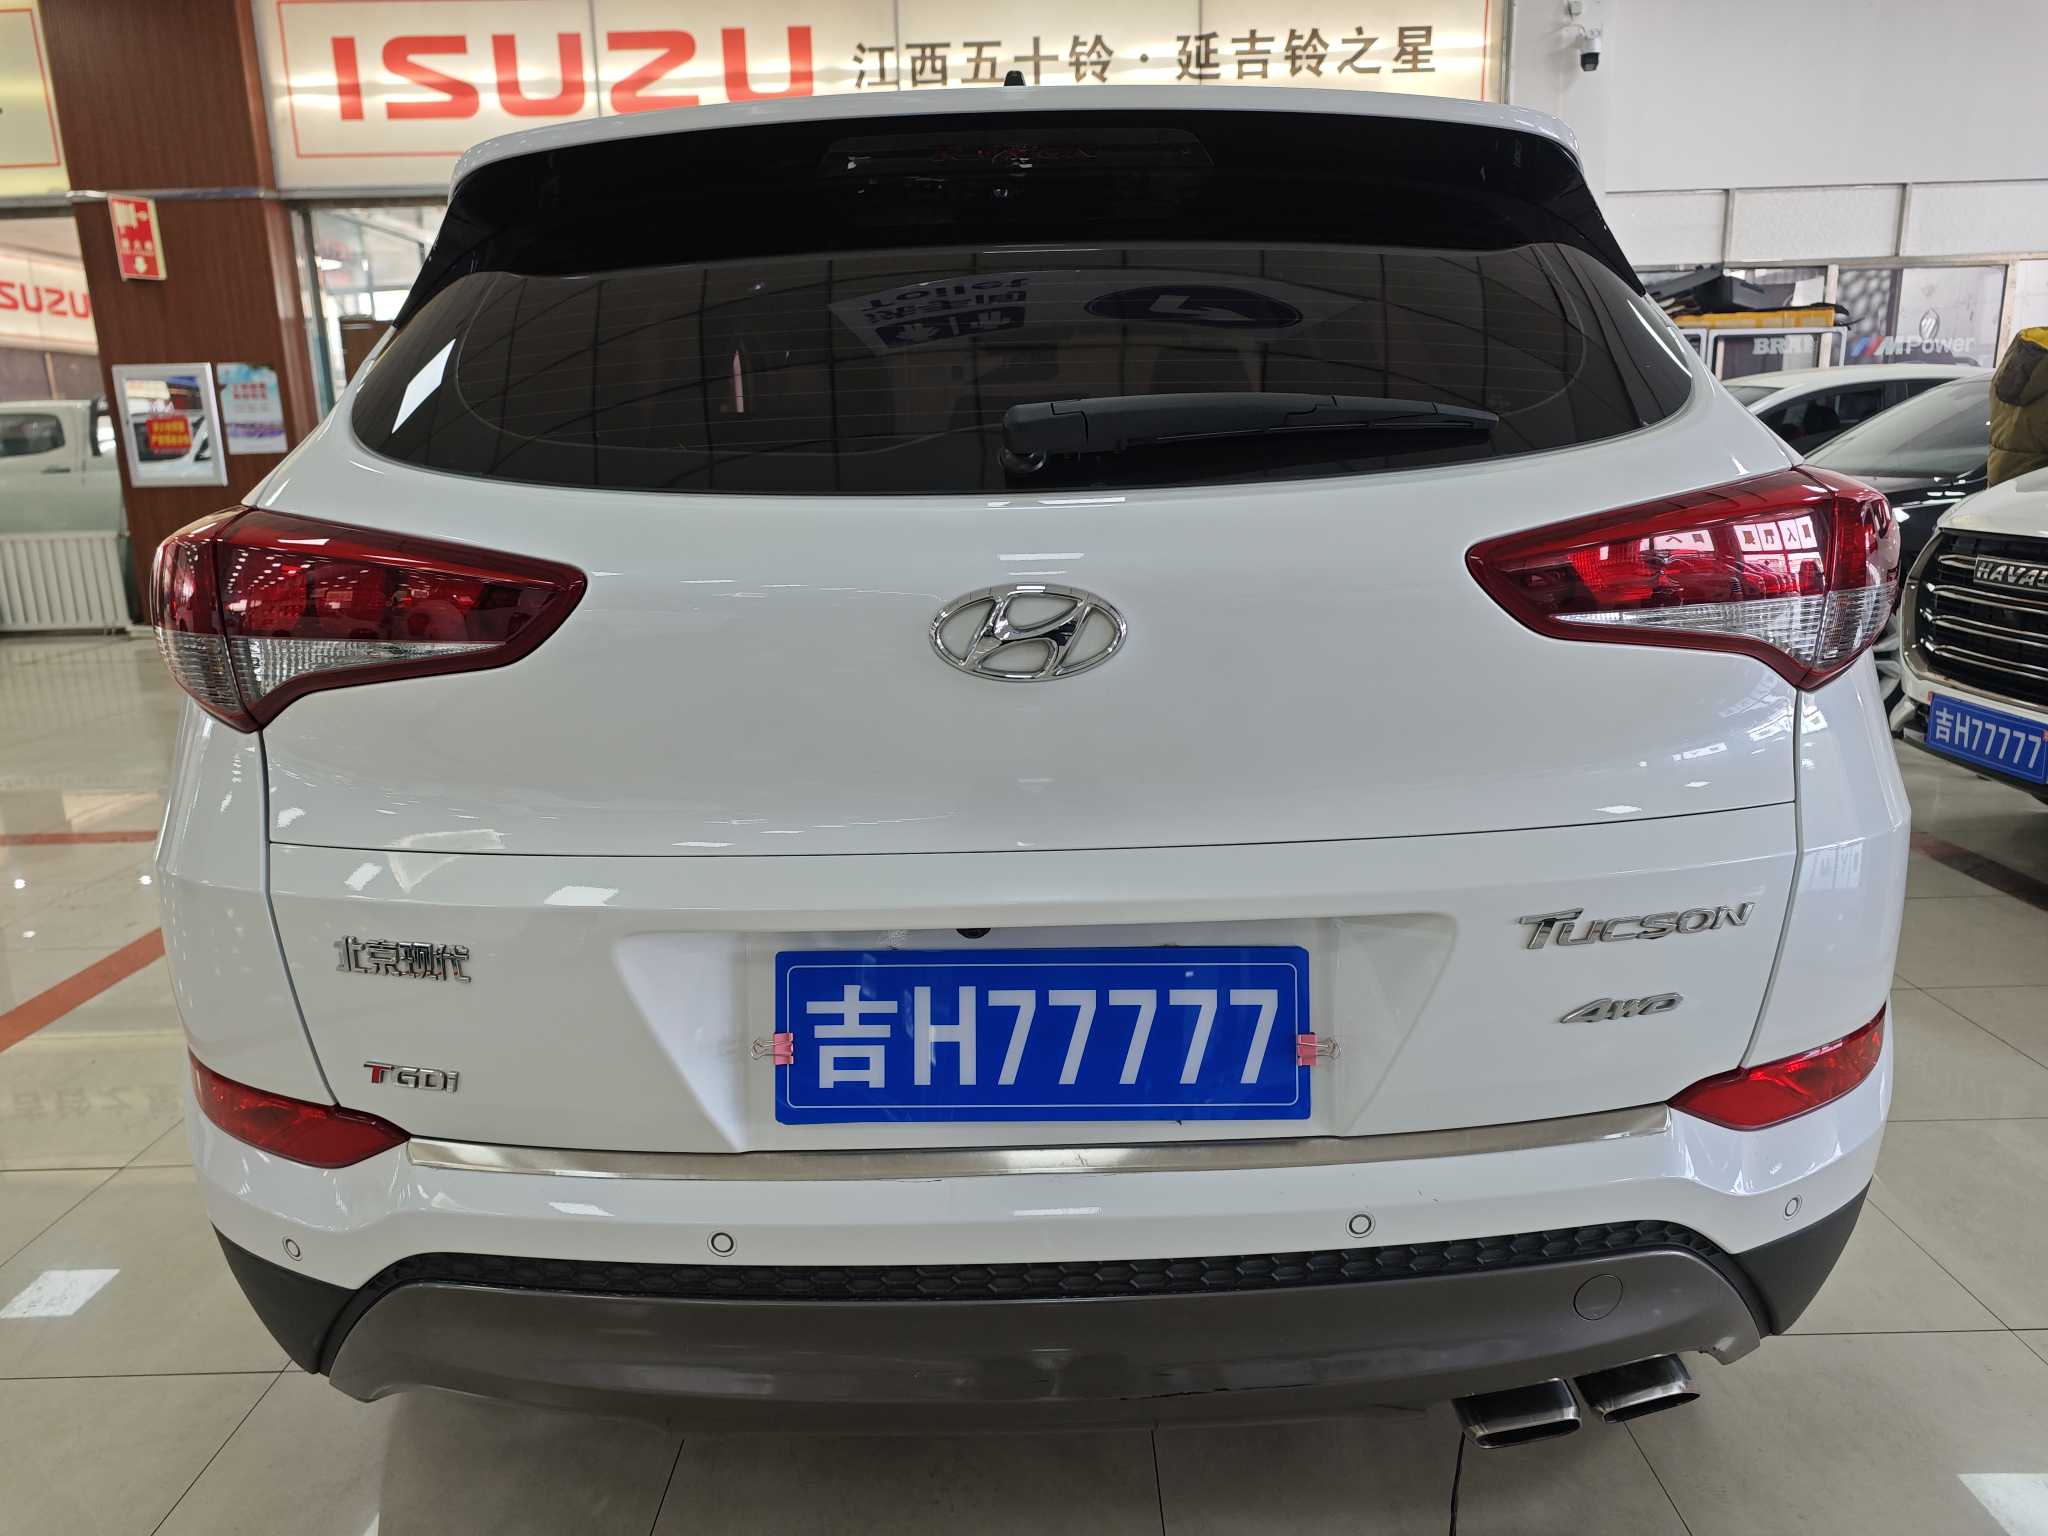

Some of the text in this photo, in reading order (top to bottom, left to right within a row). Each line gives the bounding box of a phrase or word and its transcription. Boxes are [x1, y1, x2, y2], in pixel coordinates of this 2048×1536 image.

[331, 26, 814, 120] ISUZU
[1935, 707, 2042, 769] 吉H77777
[334, 935, 472, 983] 北京现代
[806, 985, 1279, 1089] 吉H77777
